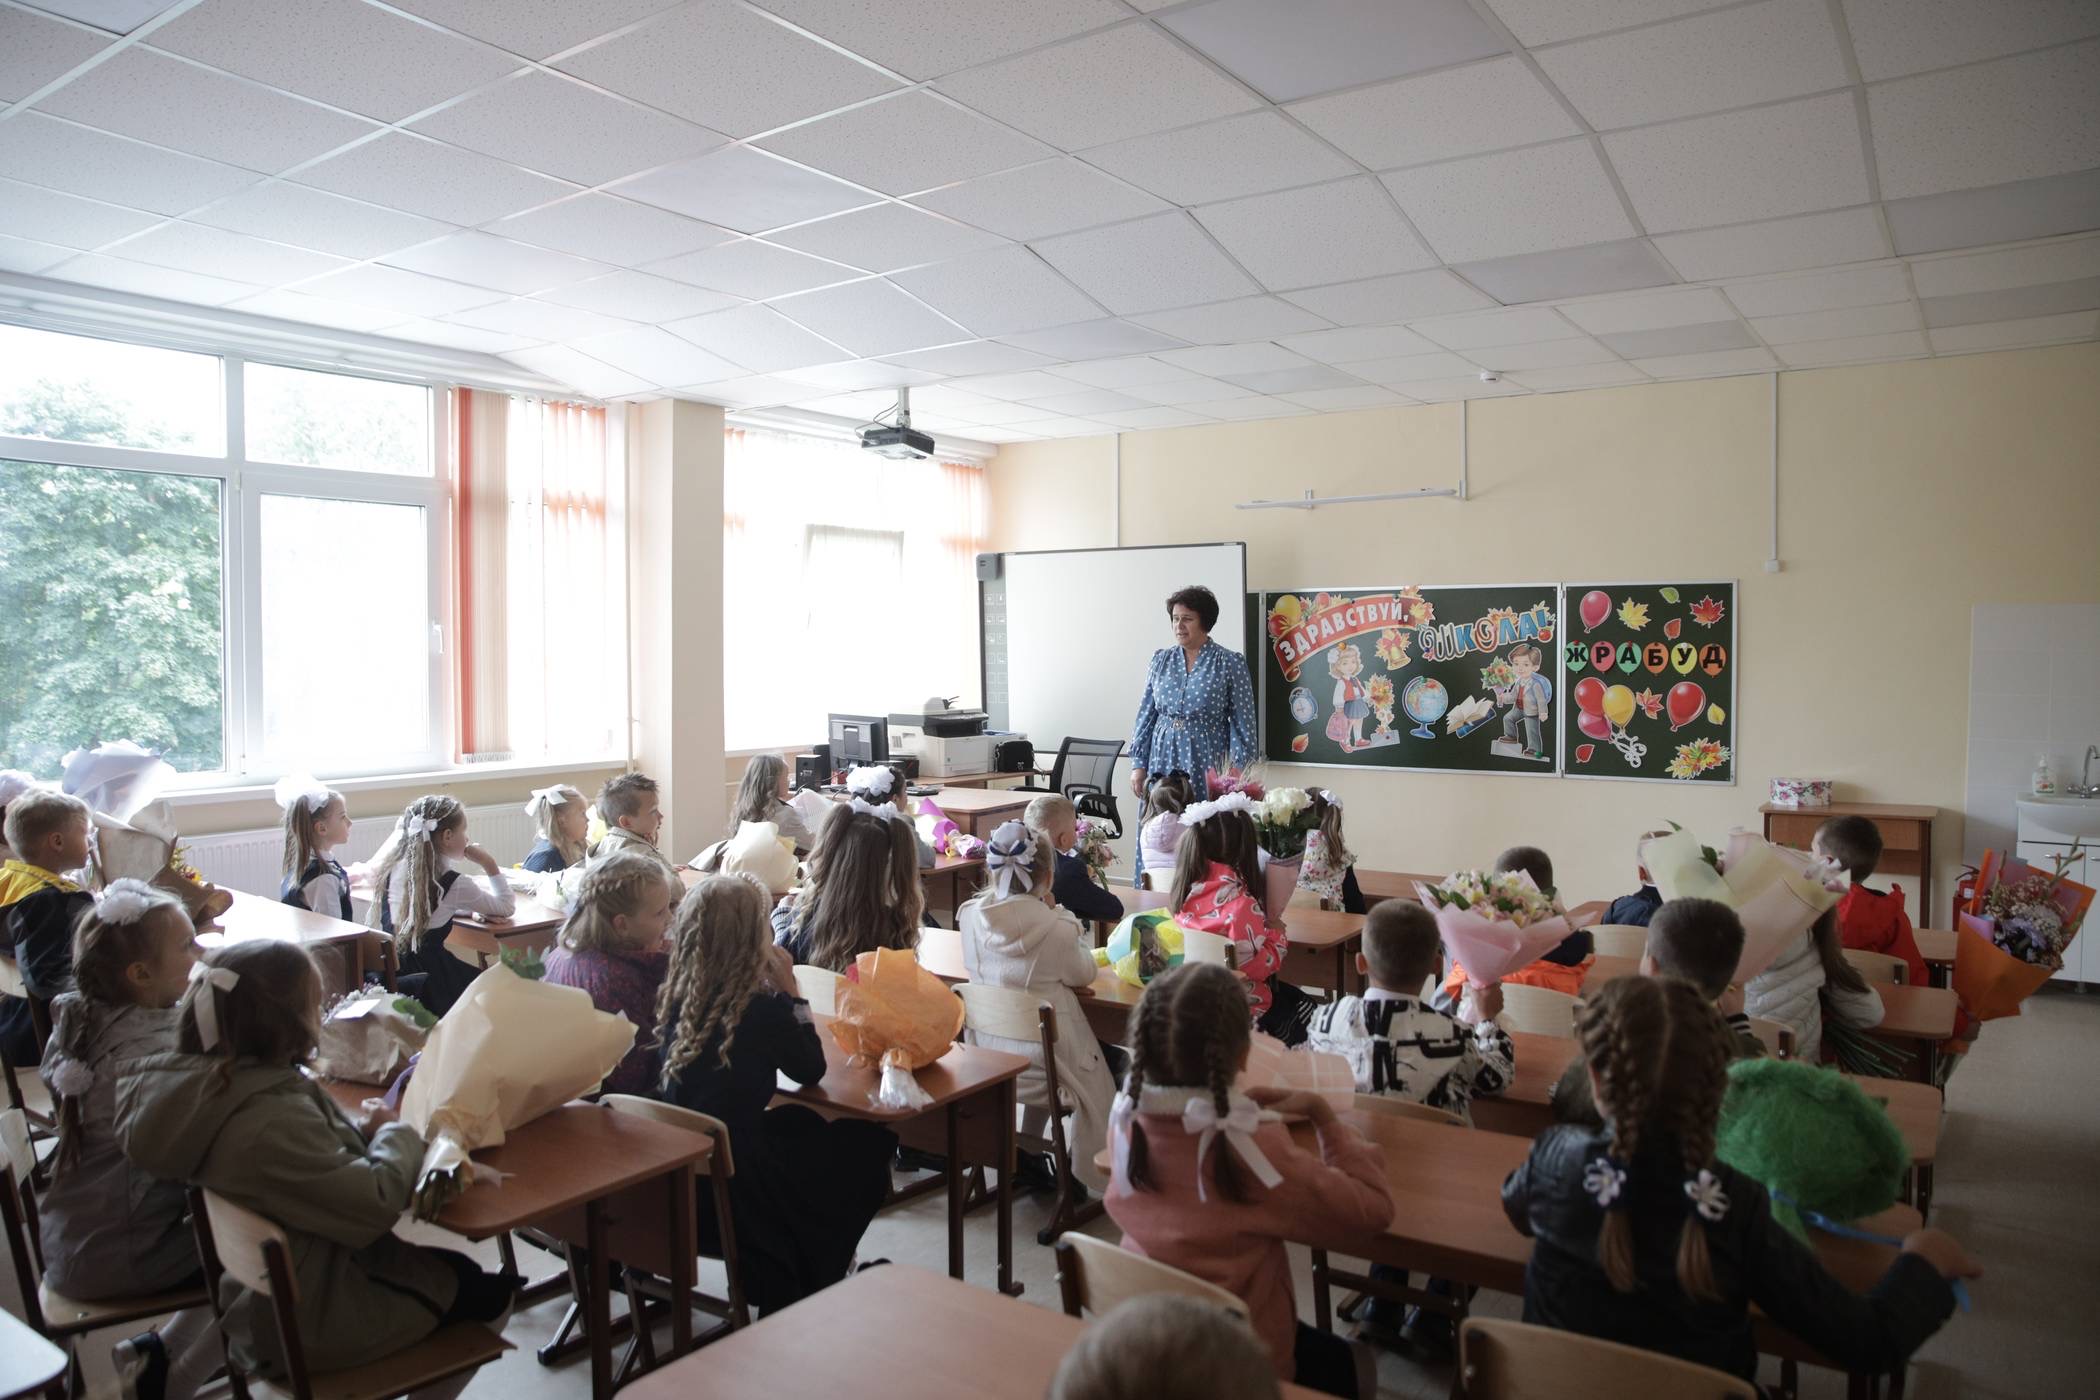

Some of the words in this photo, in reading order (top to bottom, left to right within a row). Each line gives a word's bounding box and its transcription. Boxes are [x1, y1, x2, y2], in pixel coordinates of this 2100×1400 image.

[1279, 600, 1409, 662] ЗДРАВСТВУЙ,
[1421, 609, 1552, 660] ШКОЛА!
[1566, 646, 1723, 669] ЖРАБУД
